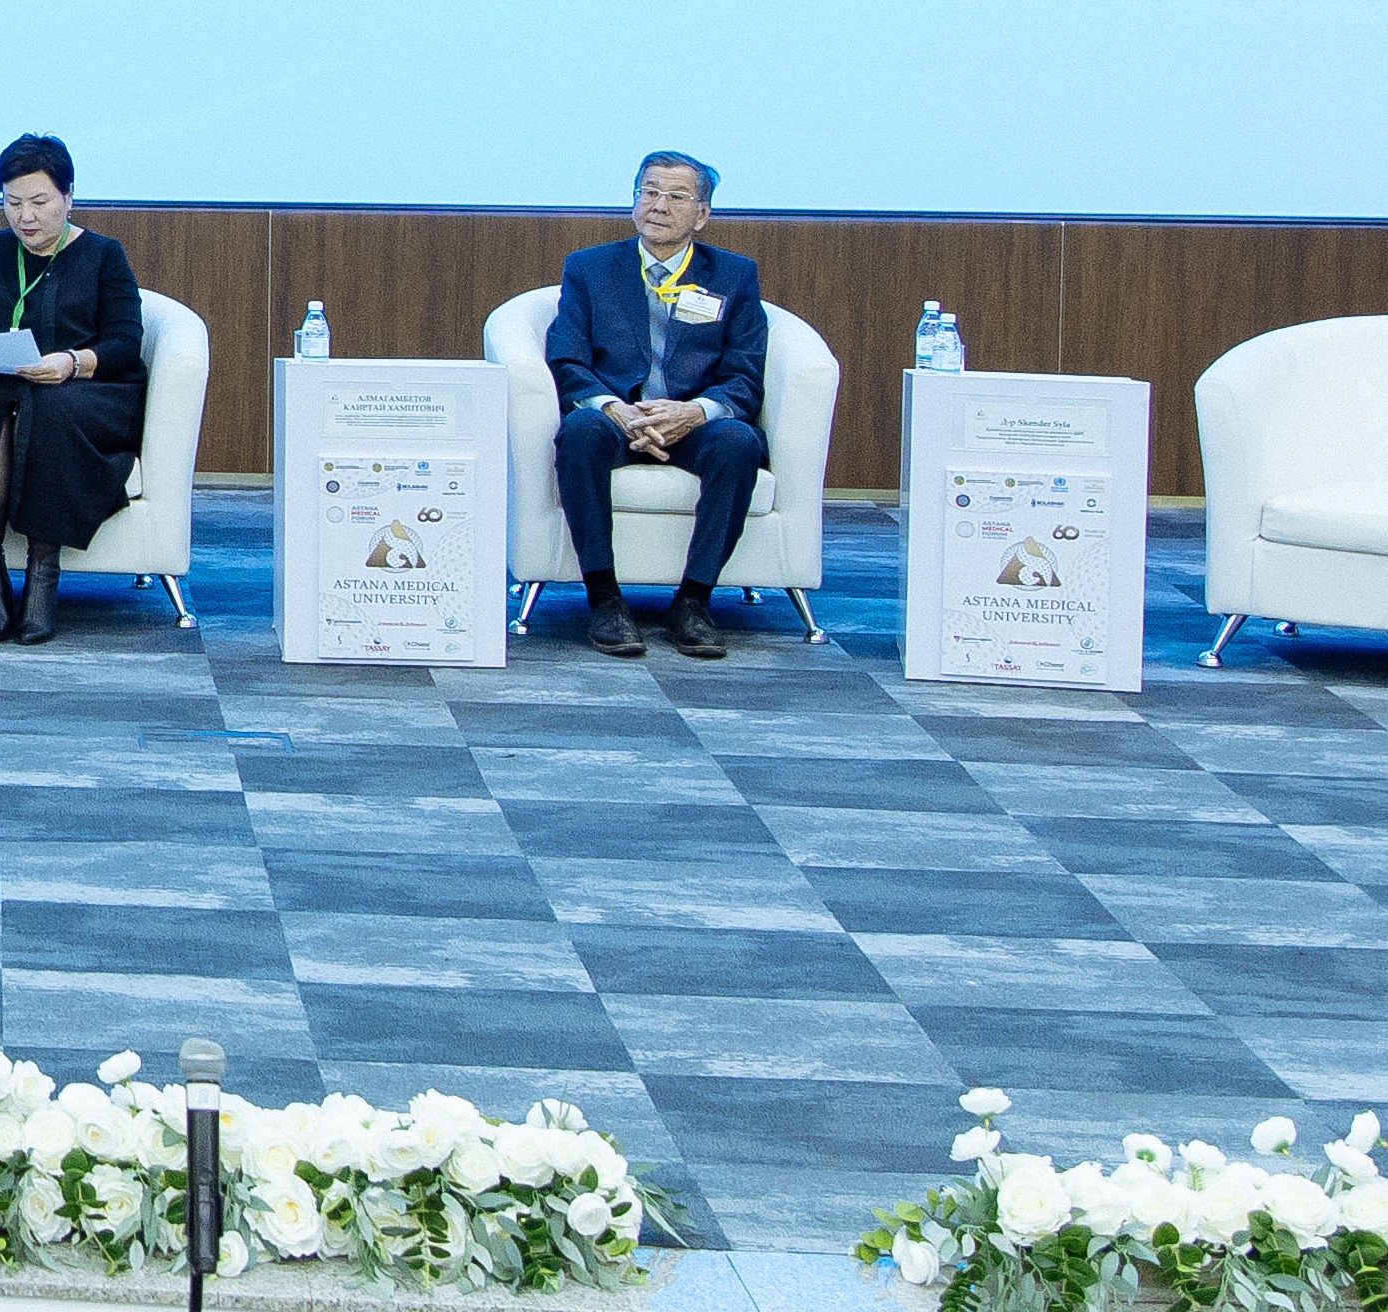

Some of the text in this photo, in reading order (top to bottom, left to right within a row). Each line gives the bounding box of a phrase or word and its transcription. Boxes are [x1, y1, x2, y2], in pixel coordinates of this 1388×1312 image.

[417, 507, 443, 523] 60
[1053, 524, 1080, 540] 60
[334, 579, 458, 592] ASTANA MEDICAL
[352, 593, 439, 605] UNIVERSITY
[962, 596, 1095, 612] ASTANA MEDICAL
[982, 610, 1075, 626] UNIVERSITY
